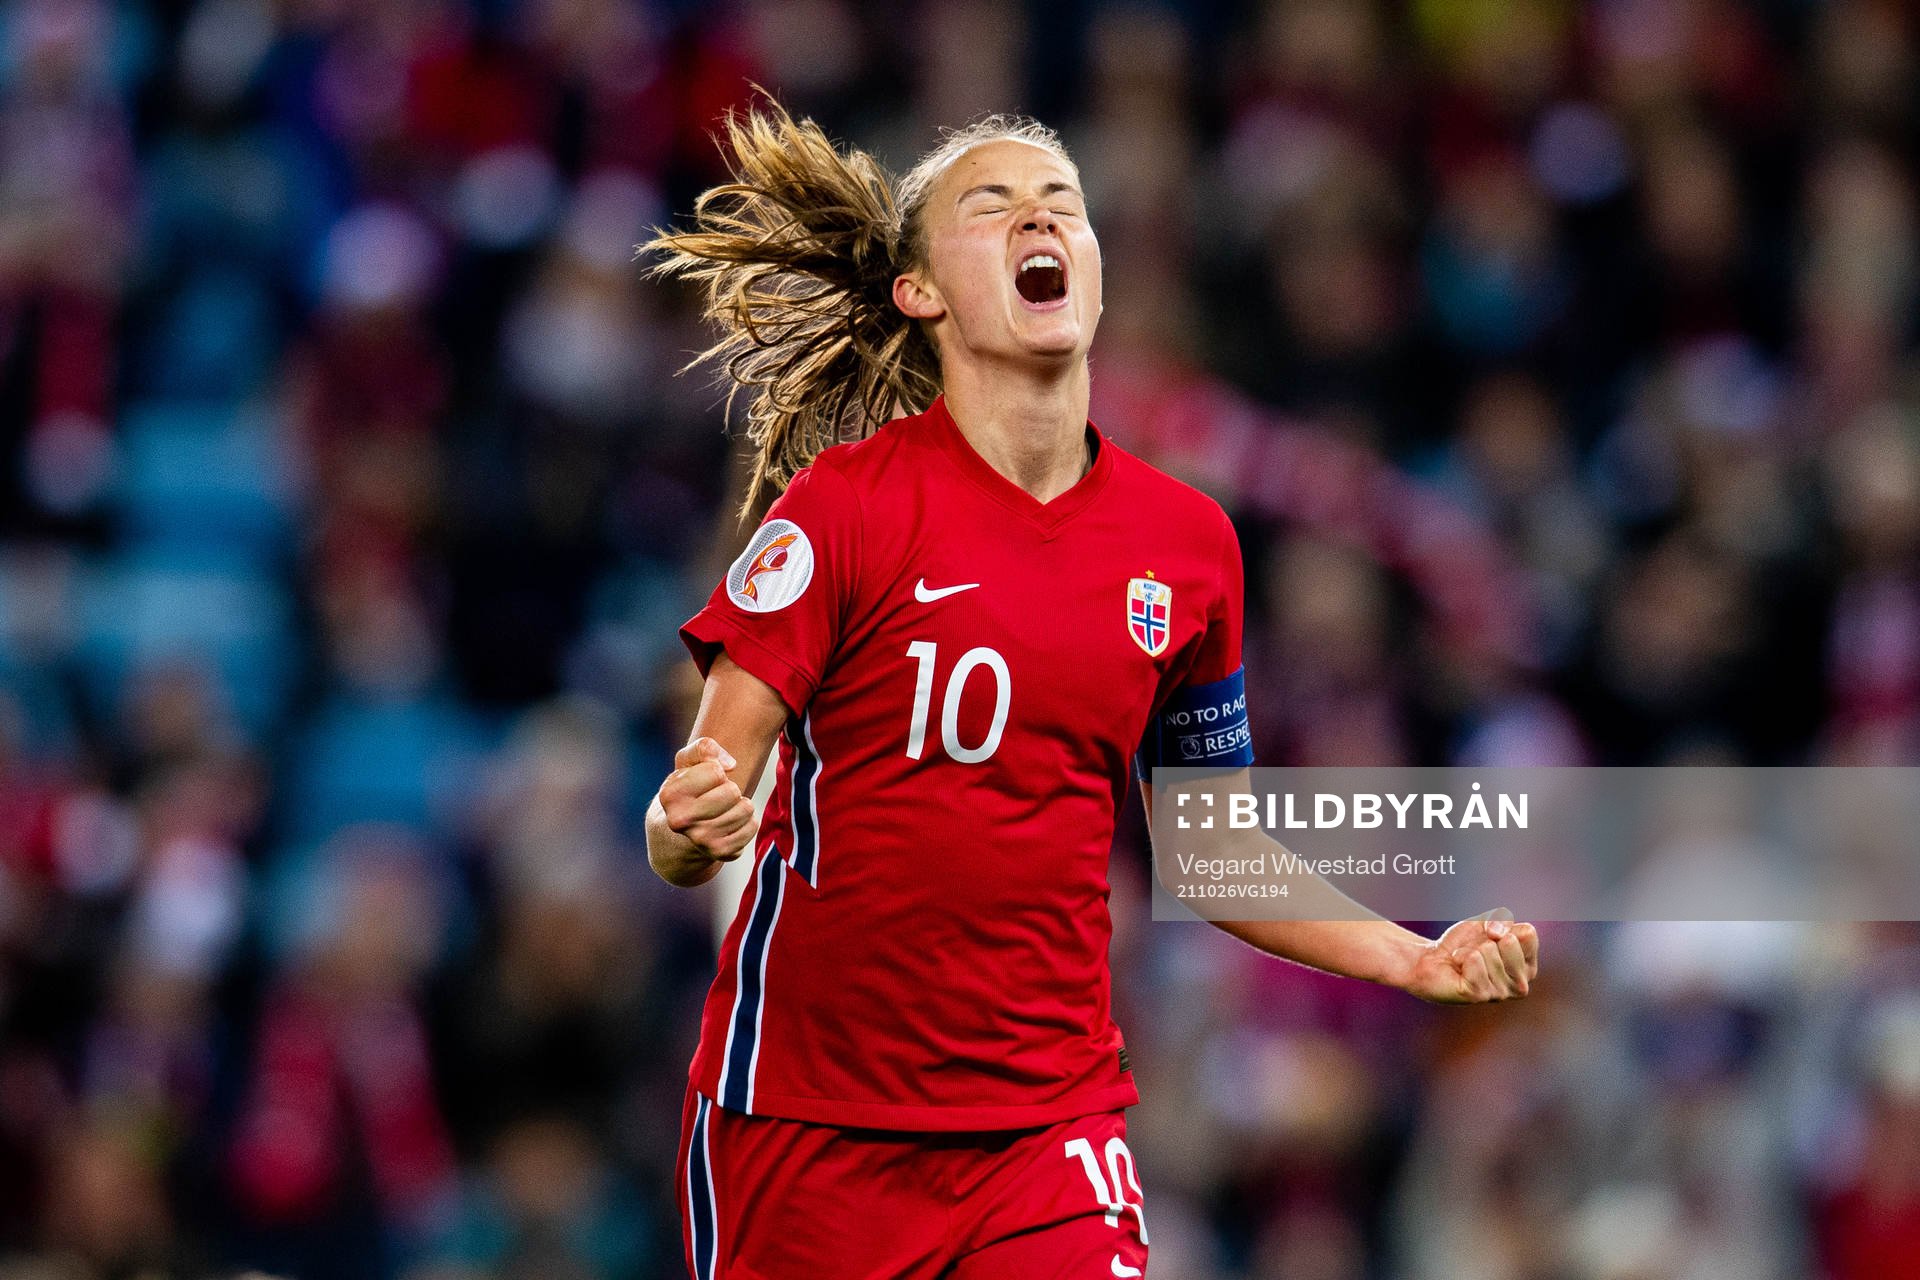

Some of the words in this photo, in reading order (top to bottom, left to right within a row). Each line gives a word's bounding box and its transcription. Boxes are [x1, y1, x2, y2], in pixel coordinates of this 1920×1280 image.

[906, 641, 1012, 763] 10
[1166, 712, 1190, 726] NO
[1193, 707, 1219, 724] TO
[1064, 1137, 1149, 1246] 10
